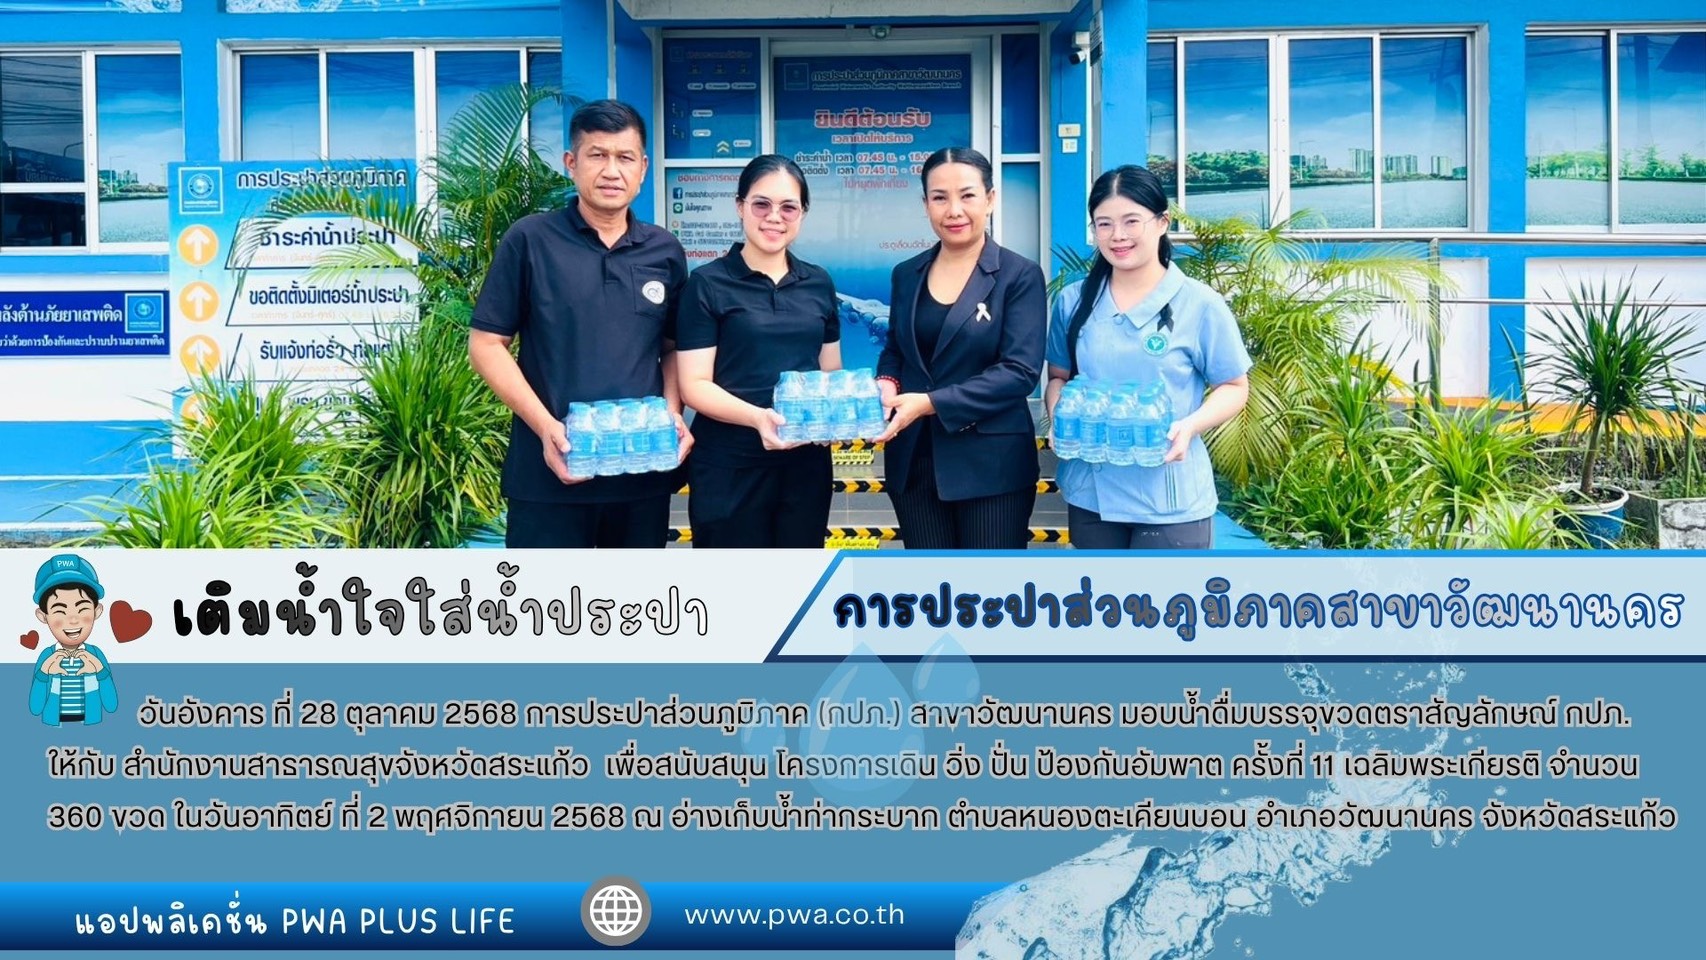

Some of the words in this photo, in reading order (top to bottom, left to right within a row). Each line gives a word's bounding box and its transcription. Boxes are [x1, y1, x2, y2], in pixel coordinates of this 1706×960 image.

[814, 107, 932, 129] ยินดีต้อนรับ
[237, 166, 408, 192] การประปาส่วนภูมิภาค
[801, 164, 829, 176] อติดตั้ง
[249, 280, 410, 306] ขอติดตั้งมิเตอร์น้ำประปา
[259, 335, 345, 360] รับแจ้งท่อรั่ว
[352, 338, 393, 360] ท่อแต
